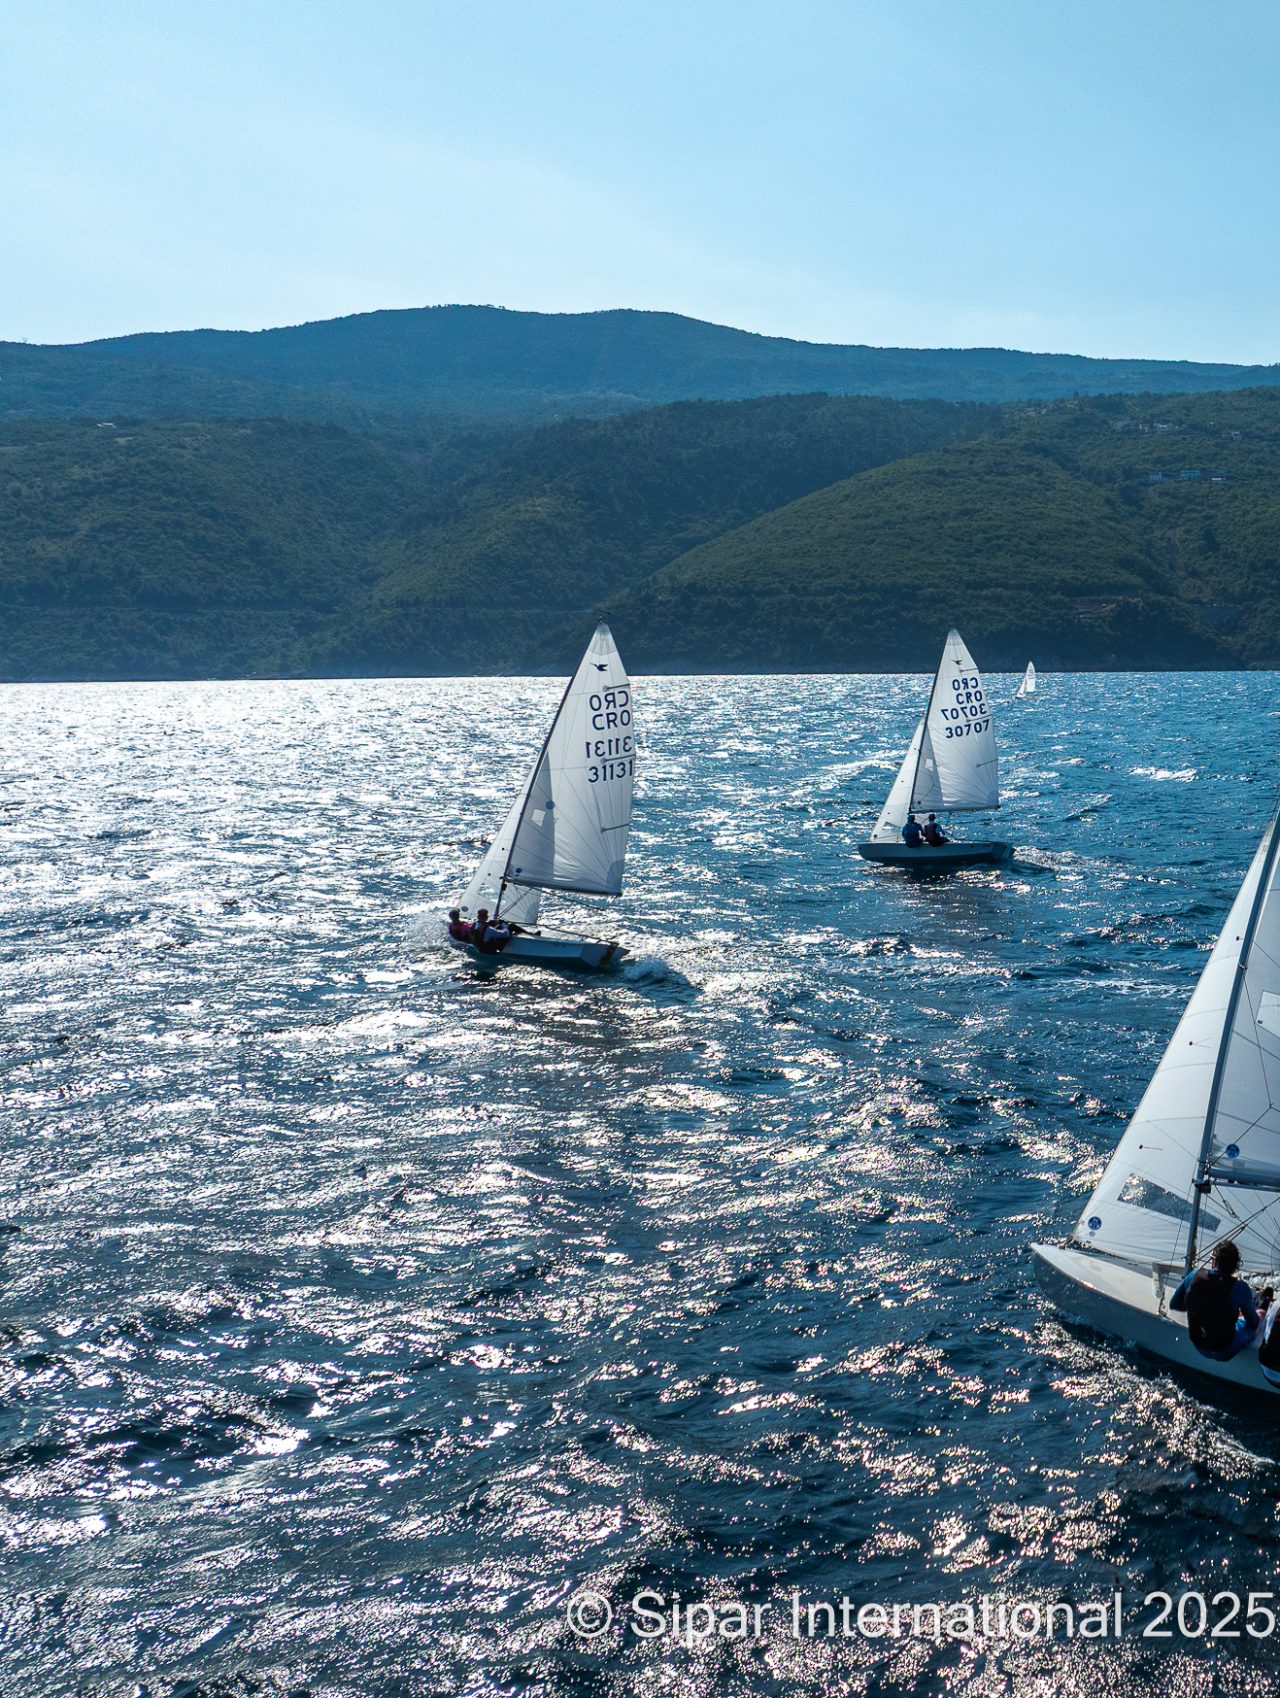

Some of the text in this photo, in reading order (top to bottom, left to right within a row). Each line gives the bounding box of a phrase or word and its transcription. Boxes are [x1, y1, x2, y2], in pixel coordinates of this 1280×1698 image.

[956, 690, 983, 705] CRO
[592, 709, 631, 731] CRO
[945, 719, 990, 739] 30707
[588, 760, 633, 783] 31131
